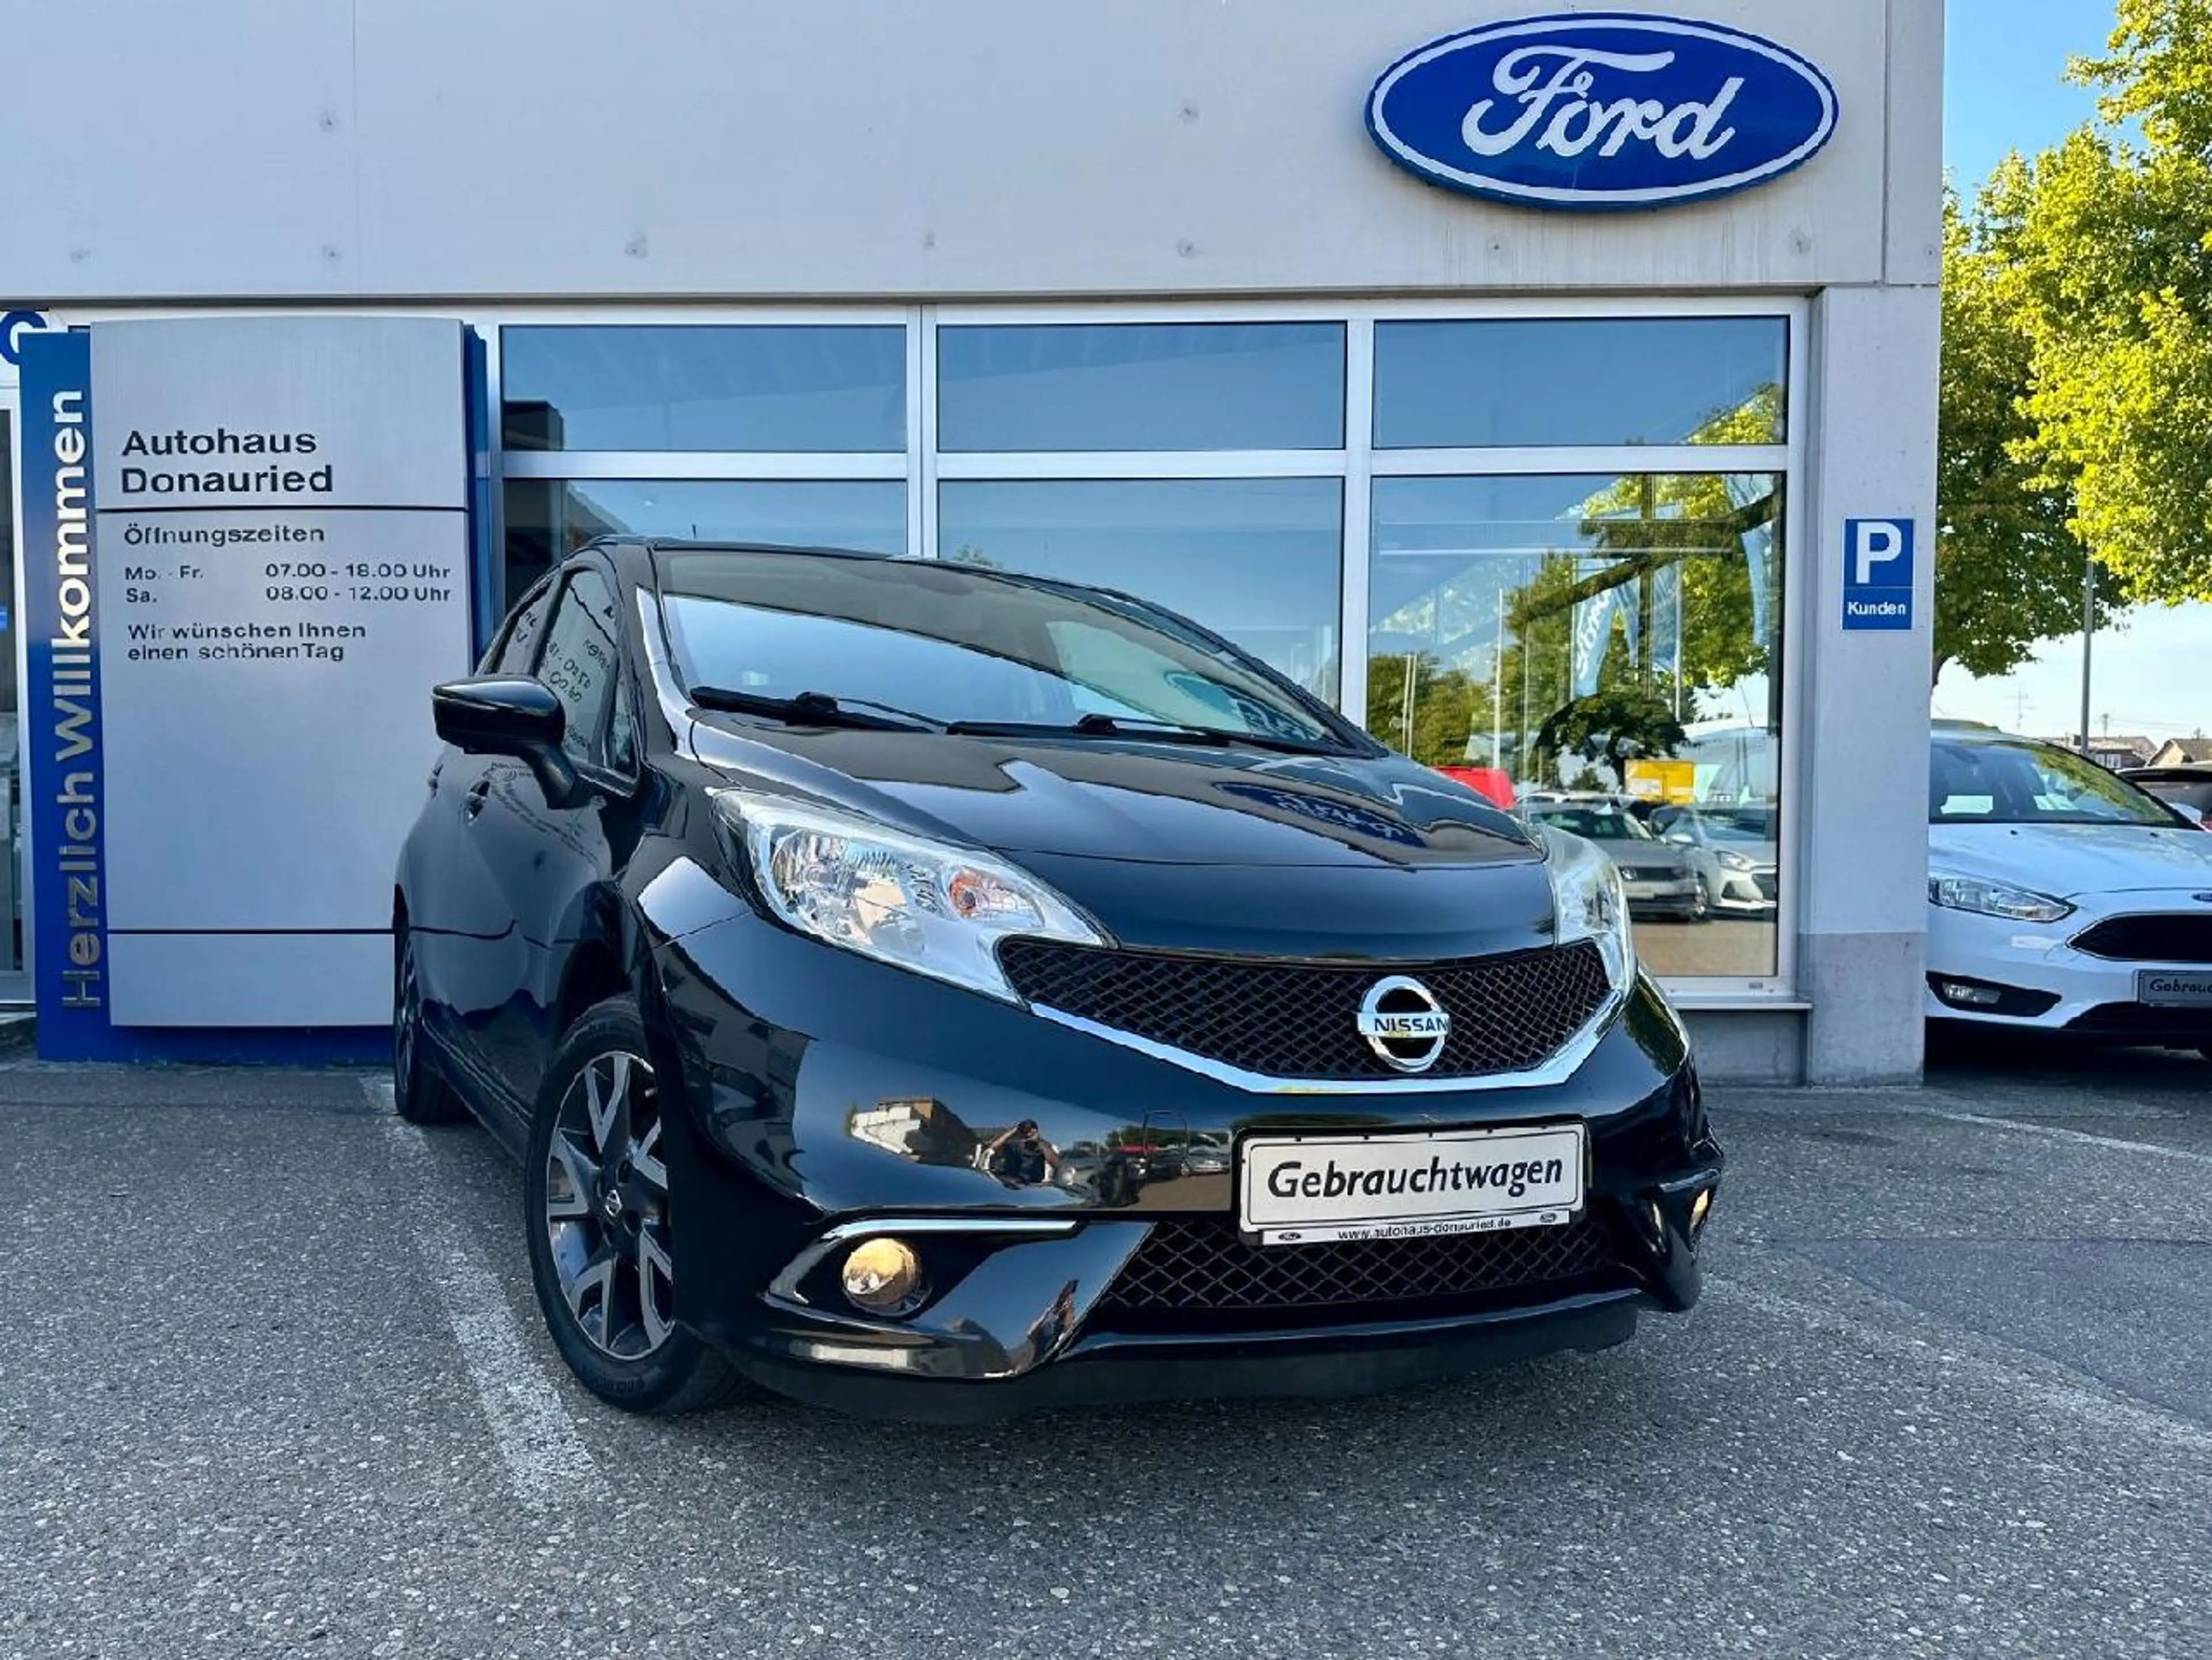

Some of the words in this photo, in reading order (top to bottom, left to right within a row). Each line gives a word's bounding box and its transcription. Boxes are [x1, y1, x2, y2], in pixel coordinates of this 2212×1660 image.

[1461, 45, 1744, 160] Ford
[120, 427, 317, 457] Autohaus
[120, 464, 333, 495] Donauried
[124, 522, 325, 548] Öffnungszeiten
[1855, 521, 1902, 584] P
[51, 389, 95, 762] Willkommen
[125, 566, 161, 580] Mo.
[179, 565, 204, 579] Fr.
[265, 563, 326, 578] 07.00
[345, 563, 408, 578] 18.00
[413, 563, 451, 579] Uhr
[126, 587, 158, 603] Sa.
[266, 586, 328, 601] 08.00
[348, 586, 409, 601] 12.00
[414, 586, 451, 602] Uhr
[1847, 601, 1906, 616] Kunden
[127, 624, 165, 640] Wir
[172, 622, 292, 639] wünschen
[299, 622, 367, 638] Ihnen
[127, 644, 189, 661] einen
[198, 643, 299, 661] schönen
[301, 643, 345, 662] Tag
[56, 771, 101, 1009] Herzlich
[1374, 1017, 1448, 1033] NISSAN
[1267, 1155, 1563, 1199] Gebrauchtwagen
